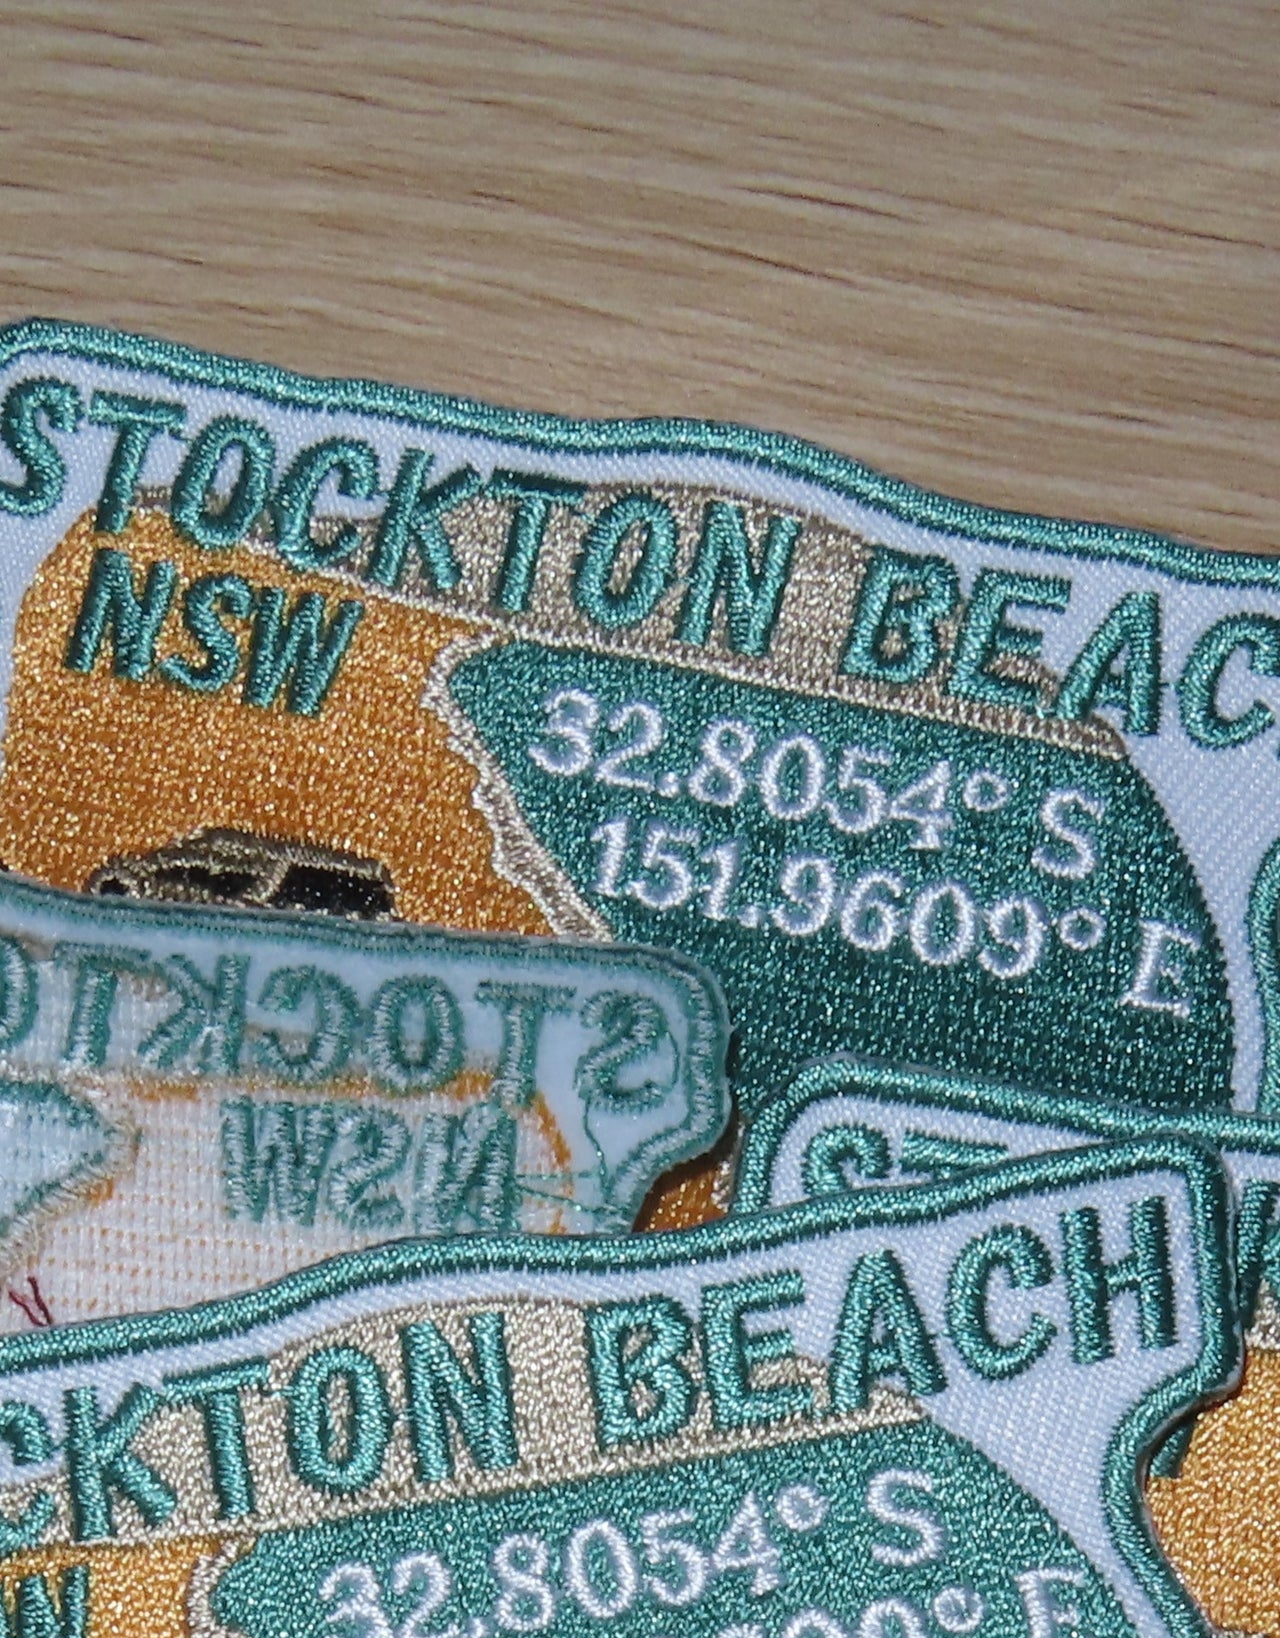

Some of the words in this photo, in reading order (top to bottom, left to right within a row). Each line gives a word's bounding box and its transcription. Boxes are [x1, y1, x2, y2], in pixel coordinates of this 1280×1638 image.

[69, 551, 364, 715] NSW
[529, 690, 1012, 852] 32.8054°
[1033, 787, 1105, 882] S
[589, 816, 1107, 981] 151.9609°
[1123, 922, 1203, 1017] E
[585, 1197, 1178, 1446] BEACH
[864, 1469, 944, 1566] S
